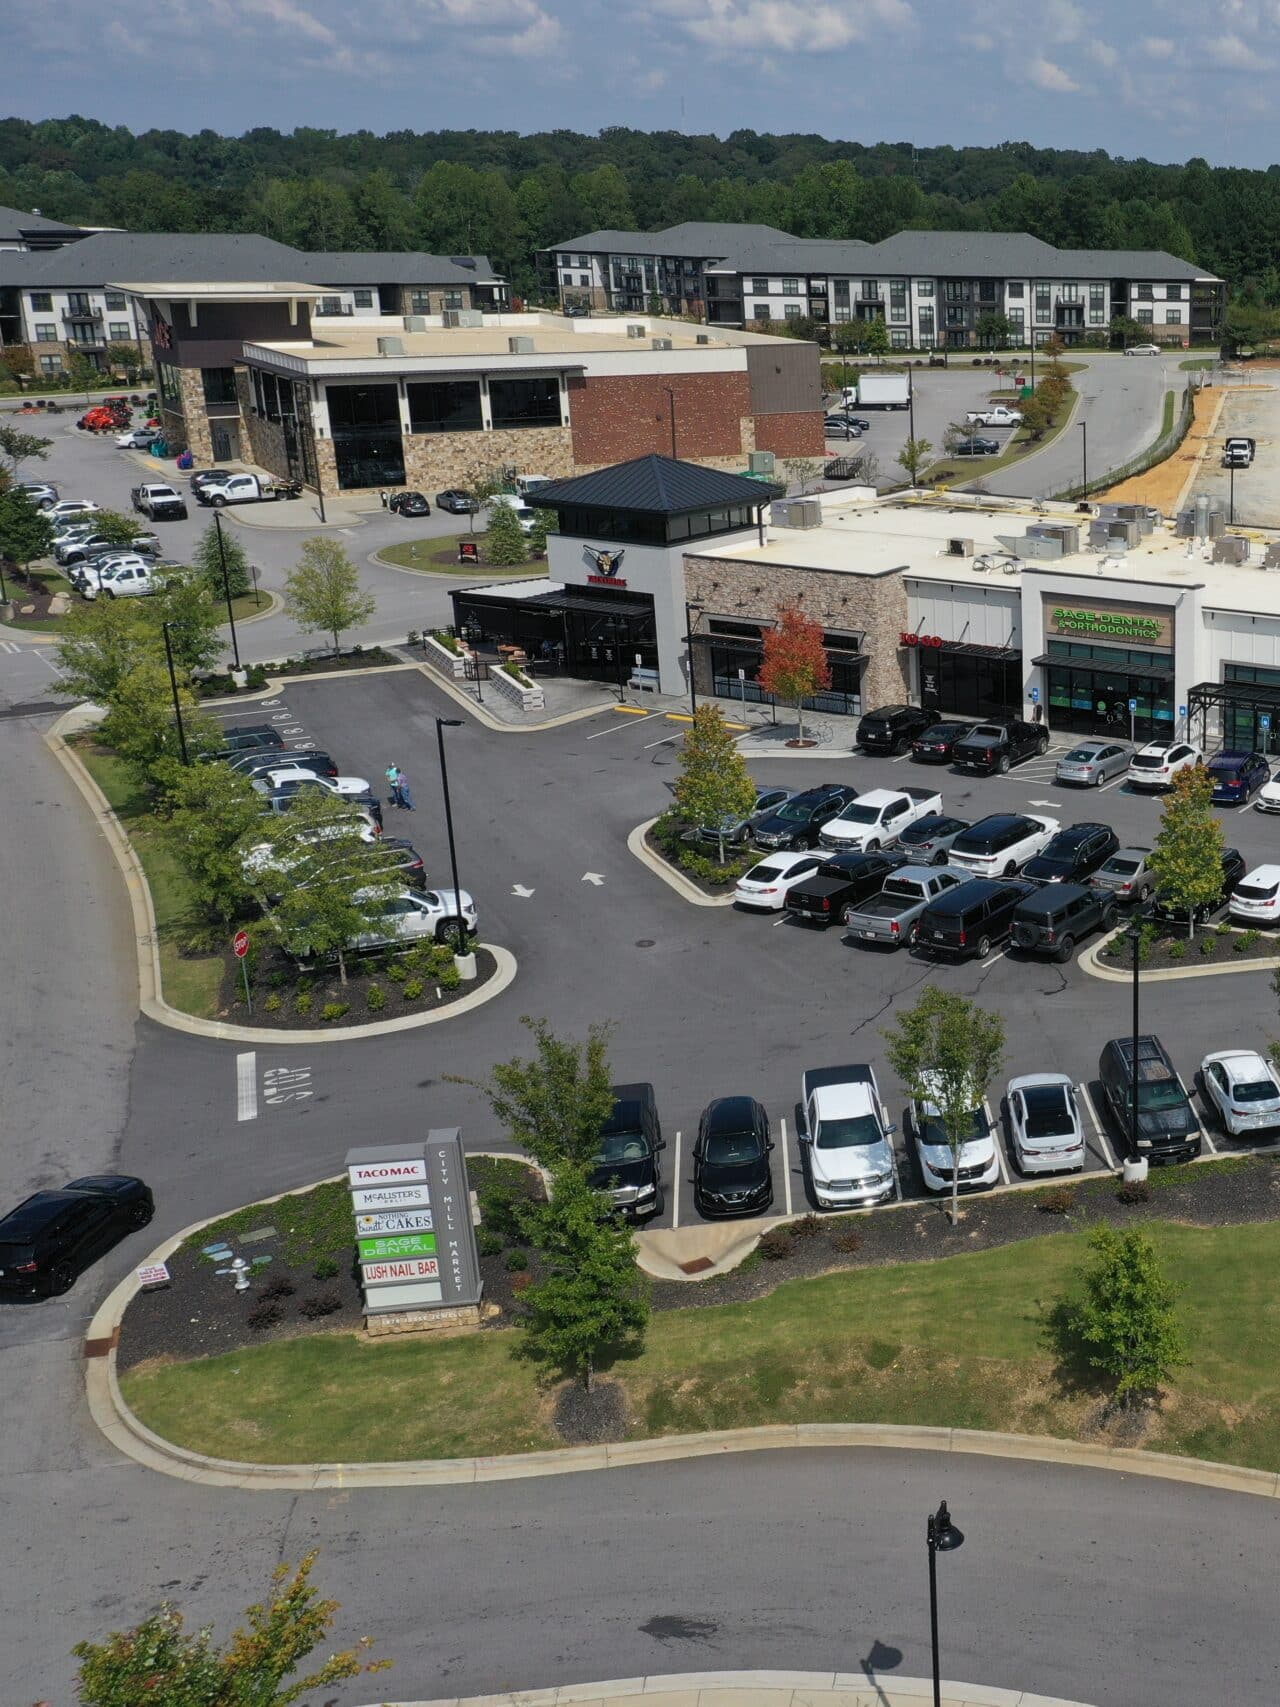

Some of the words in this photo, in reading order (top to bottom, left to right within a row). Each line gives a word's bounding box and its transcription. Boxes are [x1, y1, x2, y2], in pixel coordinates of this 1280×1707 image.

[1054, 607, 1096, 621] SAGE
[1100, 614, 1165, 629] DENTAL
[1069, 620, 1158, 639] ORTHODONTICS
[357, 1169, 389, 1179] TACO
[390, 1166, 419, 1176] MAC
[438, 1150, 449, 1185] CITY
[378, 1212, 409, 1220] NOTHING
[443, 1196, 455, 1230] MILL
[386, 1216, 432, 1230] CAKES
[363, 1244, 434, 1256] DENTAL
[375, 1237, 421, 1248] SAGE
[365, 1266, 388, 1280] LUSH
[390, 1263, 415, 1277] NAIL
[418, 1260, 438, 1275] BAR
[449, 1241, 463, 1292] MARKET
